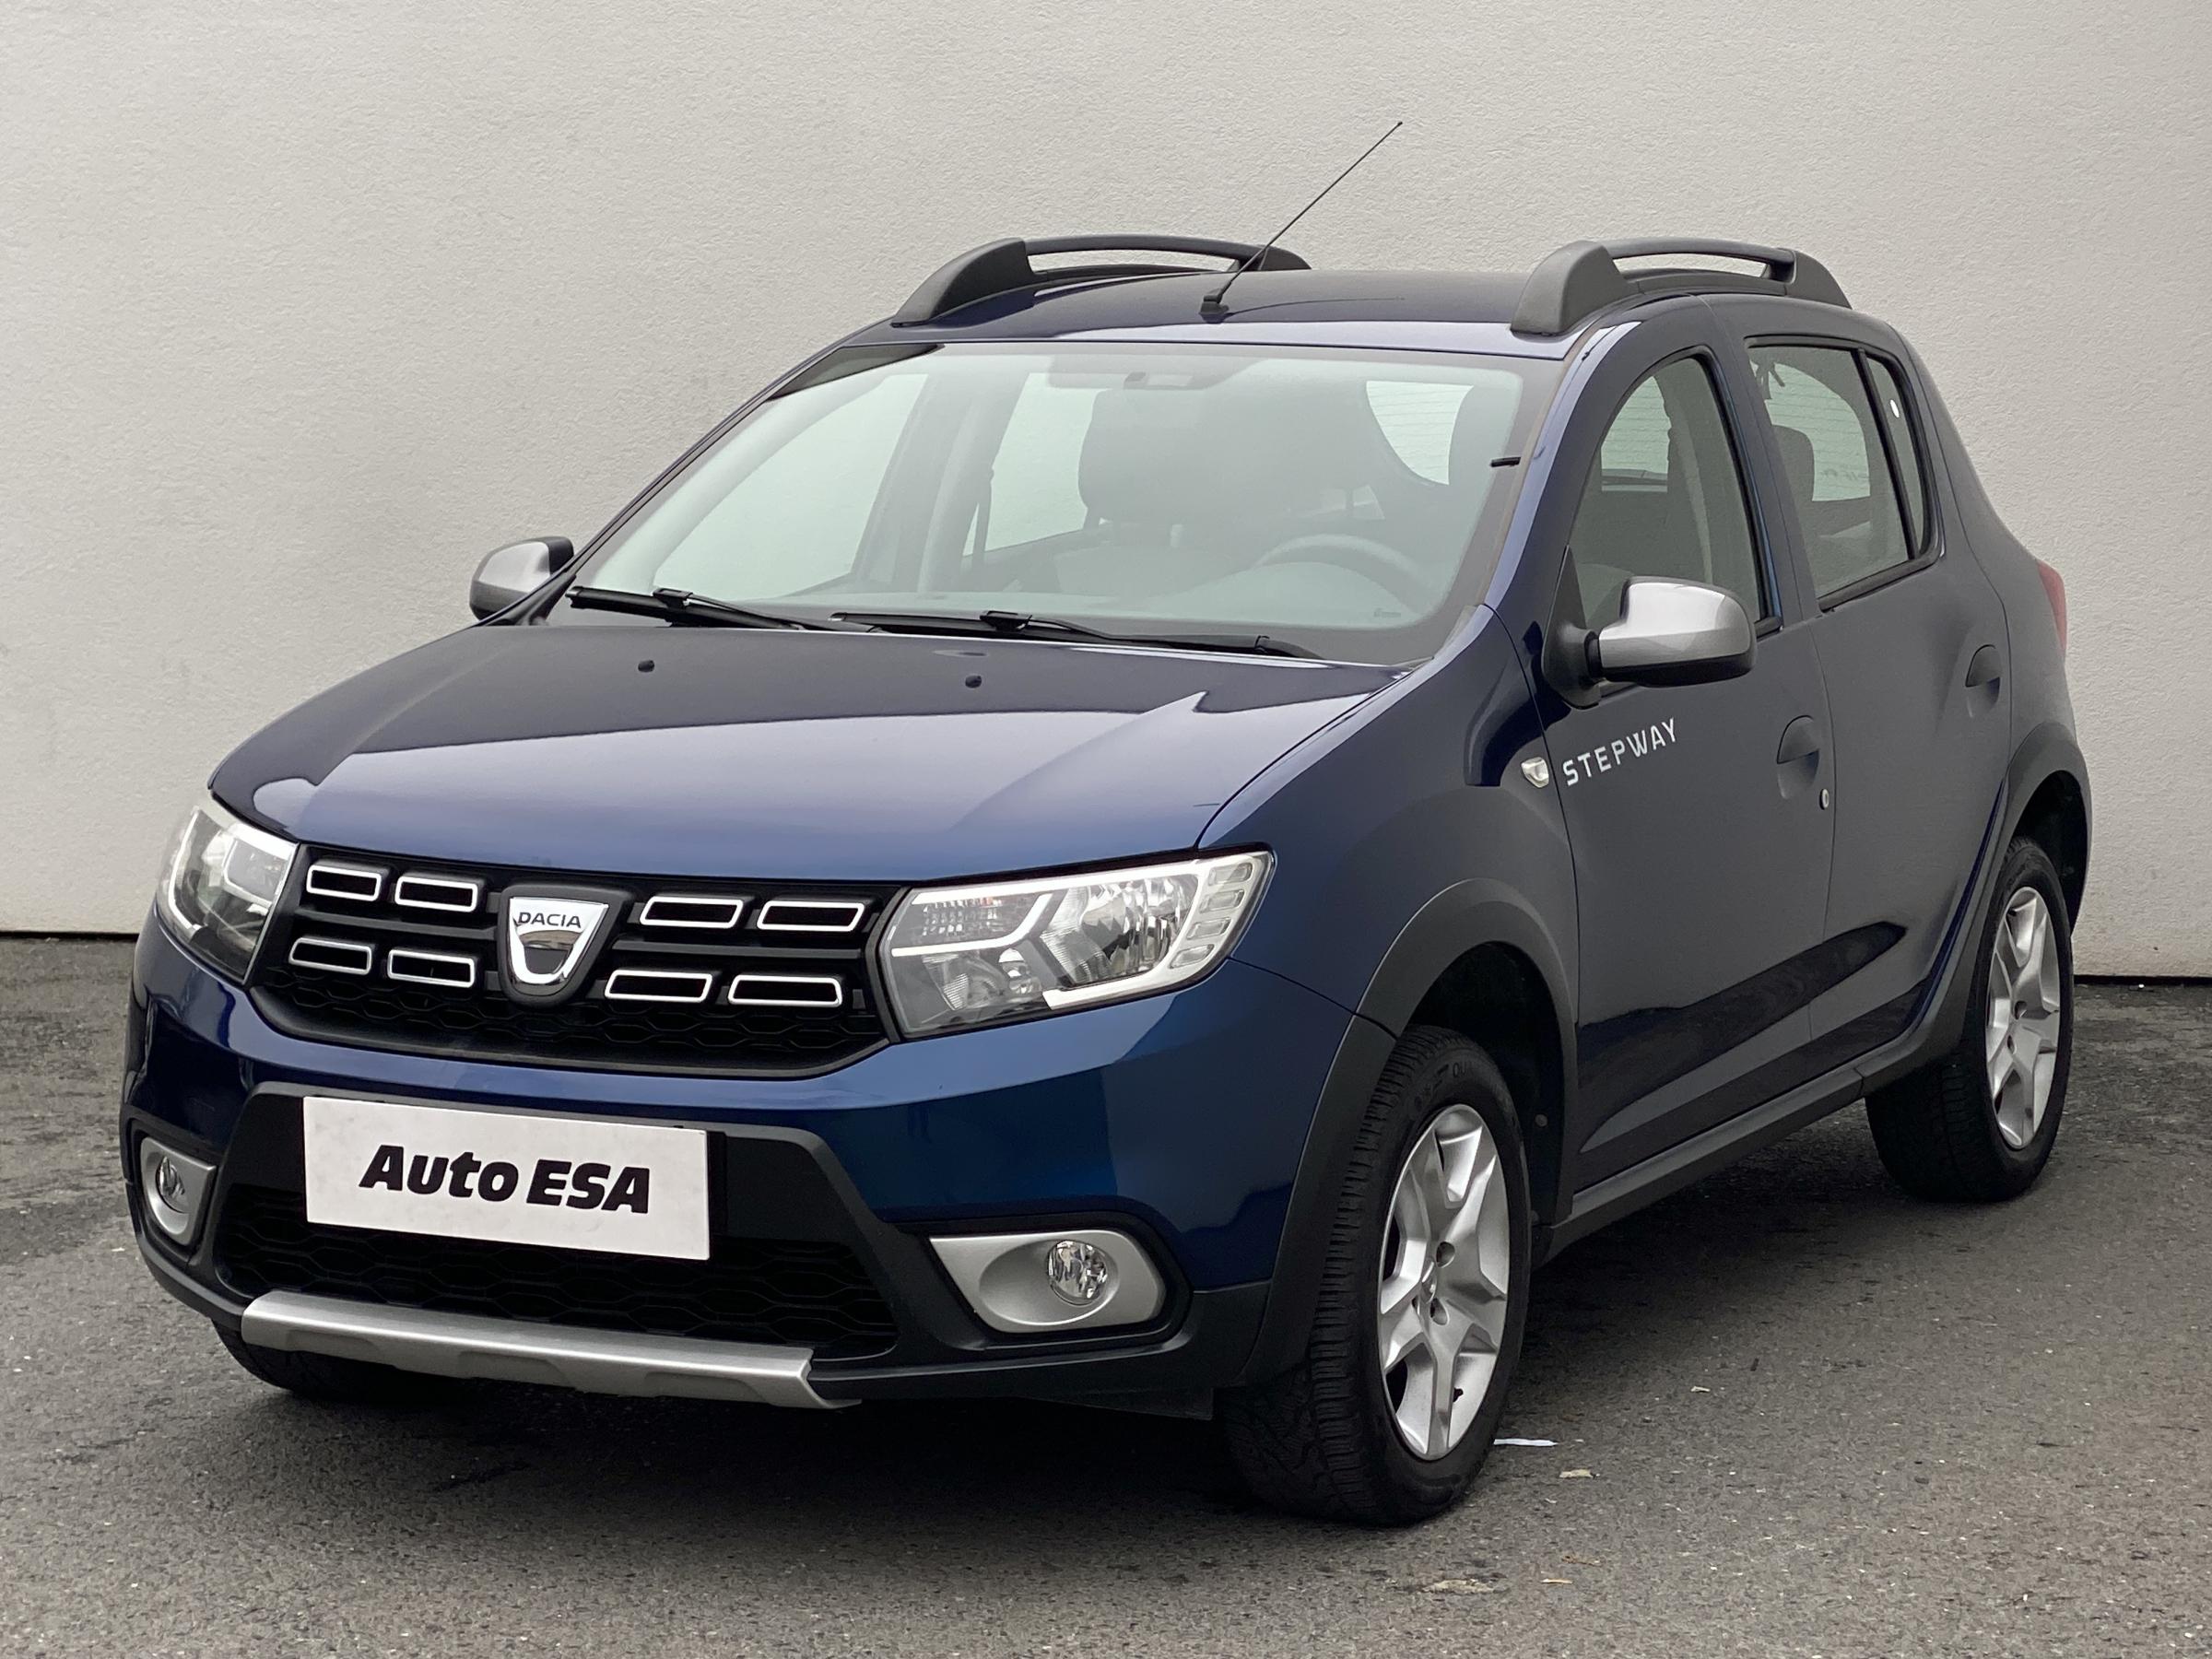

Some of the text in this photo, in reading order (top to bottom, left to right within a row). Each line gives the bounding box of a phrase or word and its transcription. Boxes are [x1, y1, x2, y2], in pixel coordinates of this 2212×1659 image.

[1562, 717, 1677, 786] STEPWAY
[518, 912, 582, 928] DACIA
[359, 1144, 650, 1215] Auto ESA
